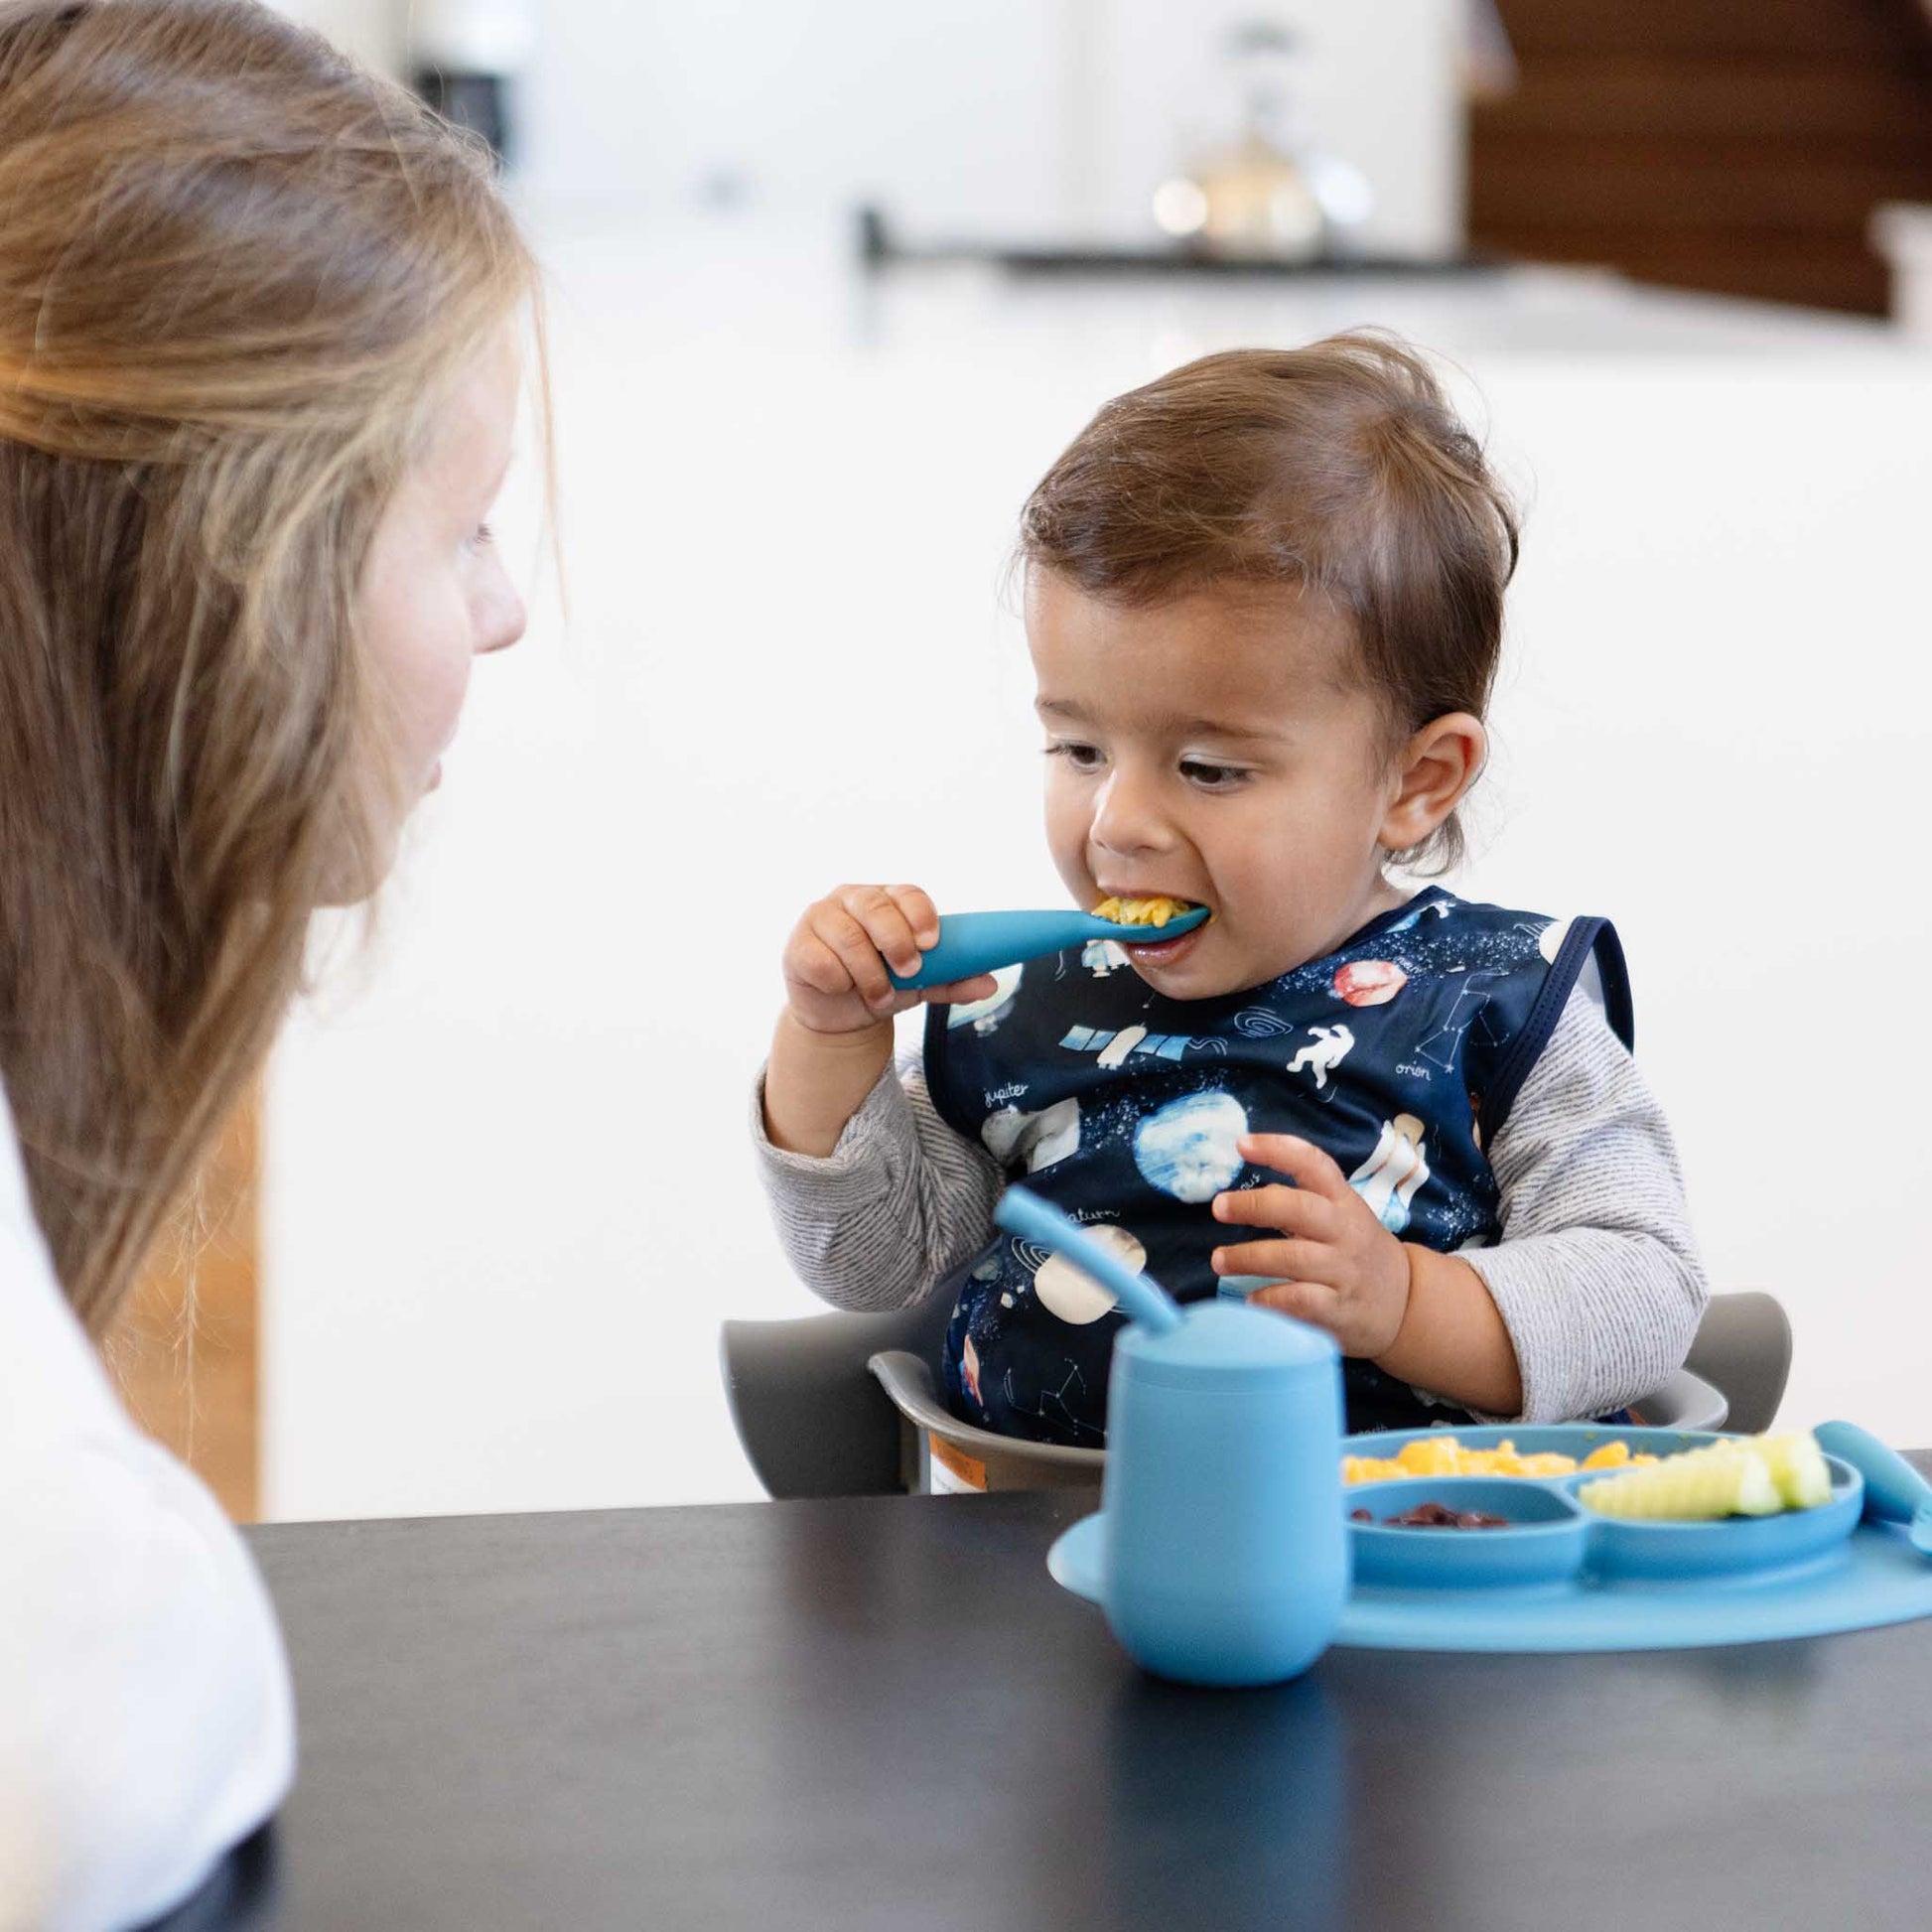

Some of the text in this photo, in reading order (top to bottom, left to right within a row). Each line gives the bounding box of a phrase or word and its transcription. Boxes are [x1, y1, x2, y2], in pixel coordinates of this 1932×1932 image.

[1395, 1060, 1432, 1081] orion
[984, 1081, 1029, 1109] jupiter
[1065, 1207, 1121, 1223] aturn
